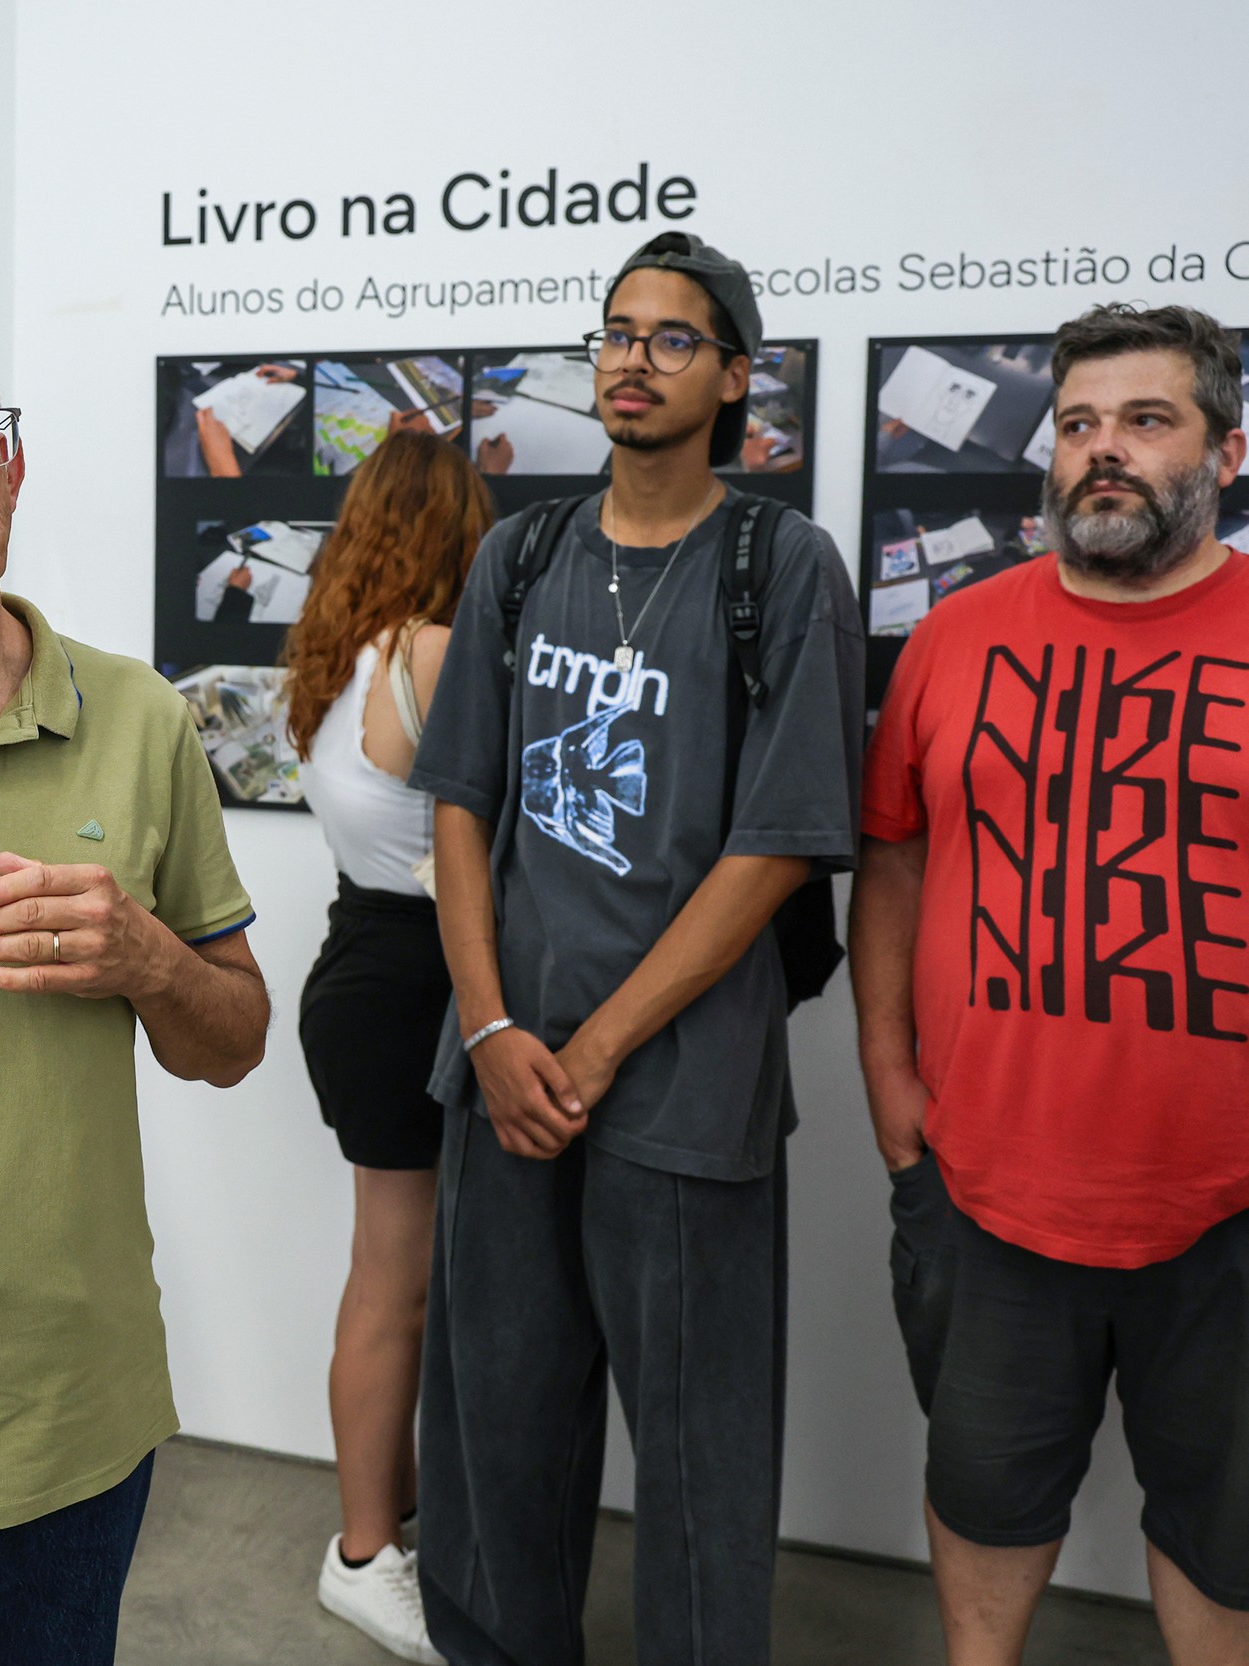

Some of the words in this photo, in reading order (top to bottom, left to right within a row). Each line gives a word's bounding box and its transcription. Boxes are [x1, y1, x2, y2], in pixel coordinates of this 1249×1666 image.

[162, 188, 318, 247] Livro
[341, 192, 417, 238] na
[440, 161, 699, 232] Cidade
[160, 275, 285, 318] Alunos
[295, 275, 345, 314] do
[750, 256, 881, 298] scolas
[897, 246, 1131, 292] Sebastião
[1147, 242, 1206, 284] da
[978, 643, 1249, 752] NIKE
